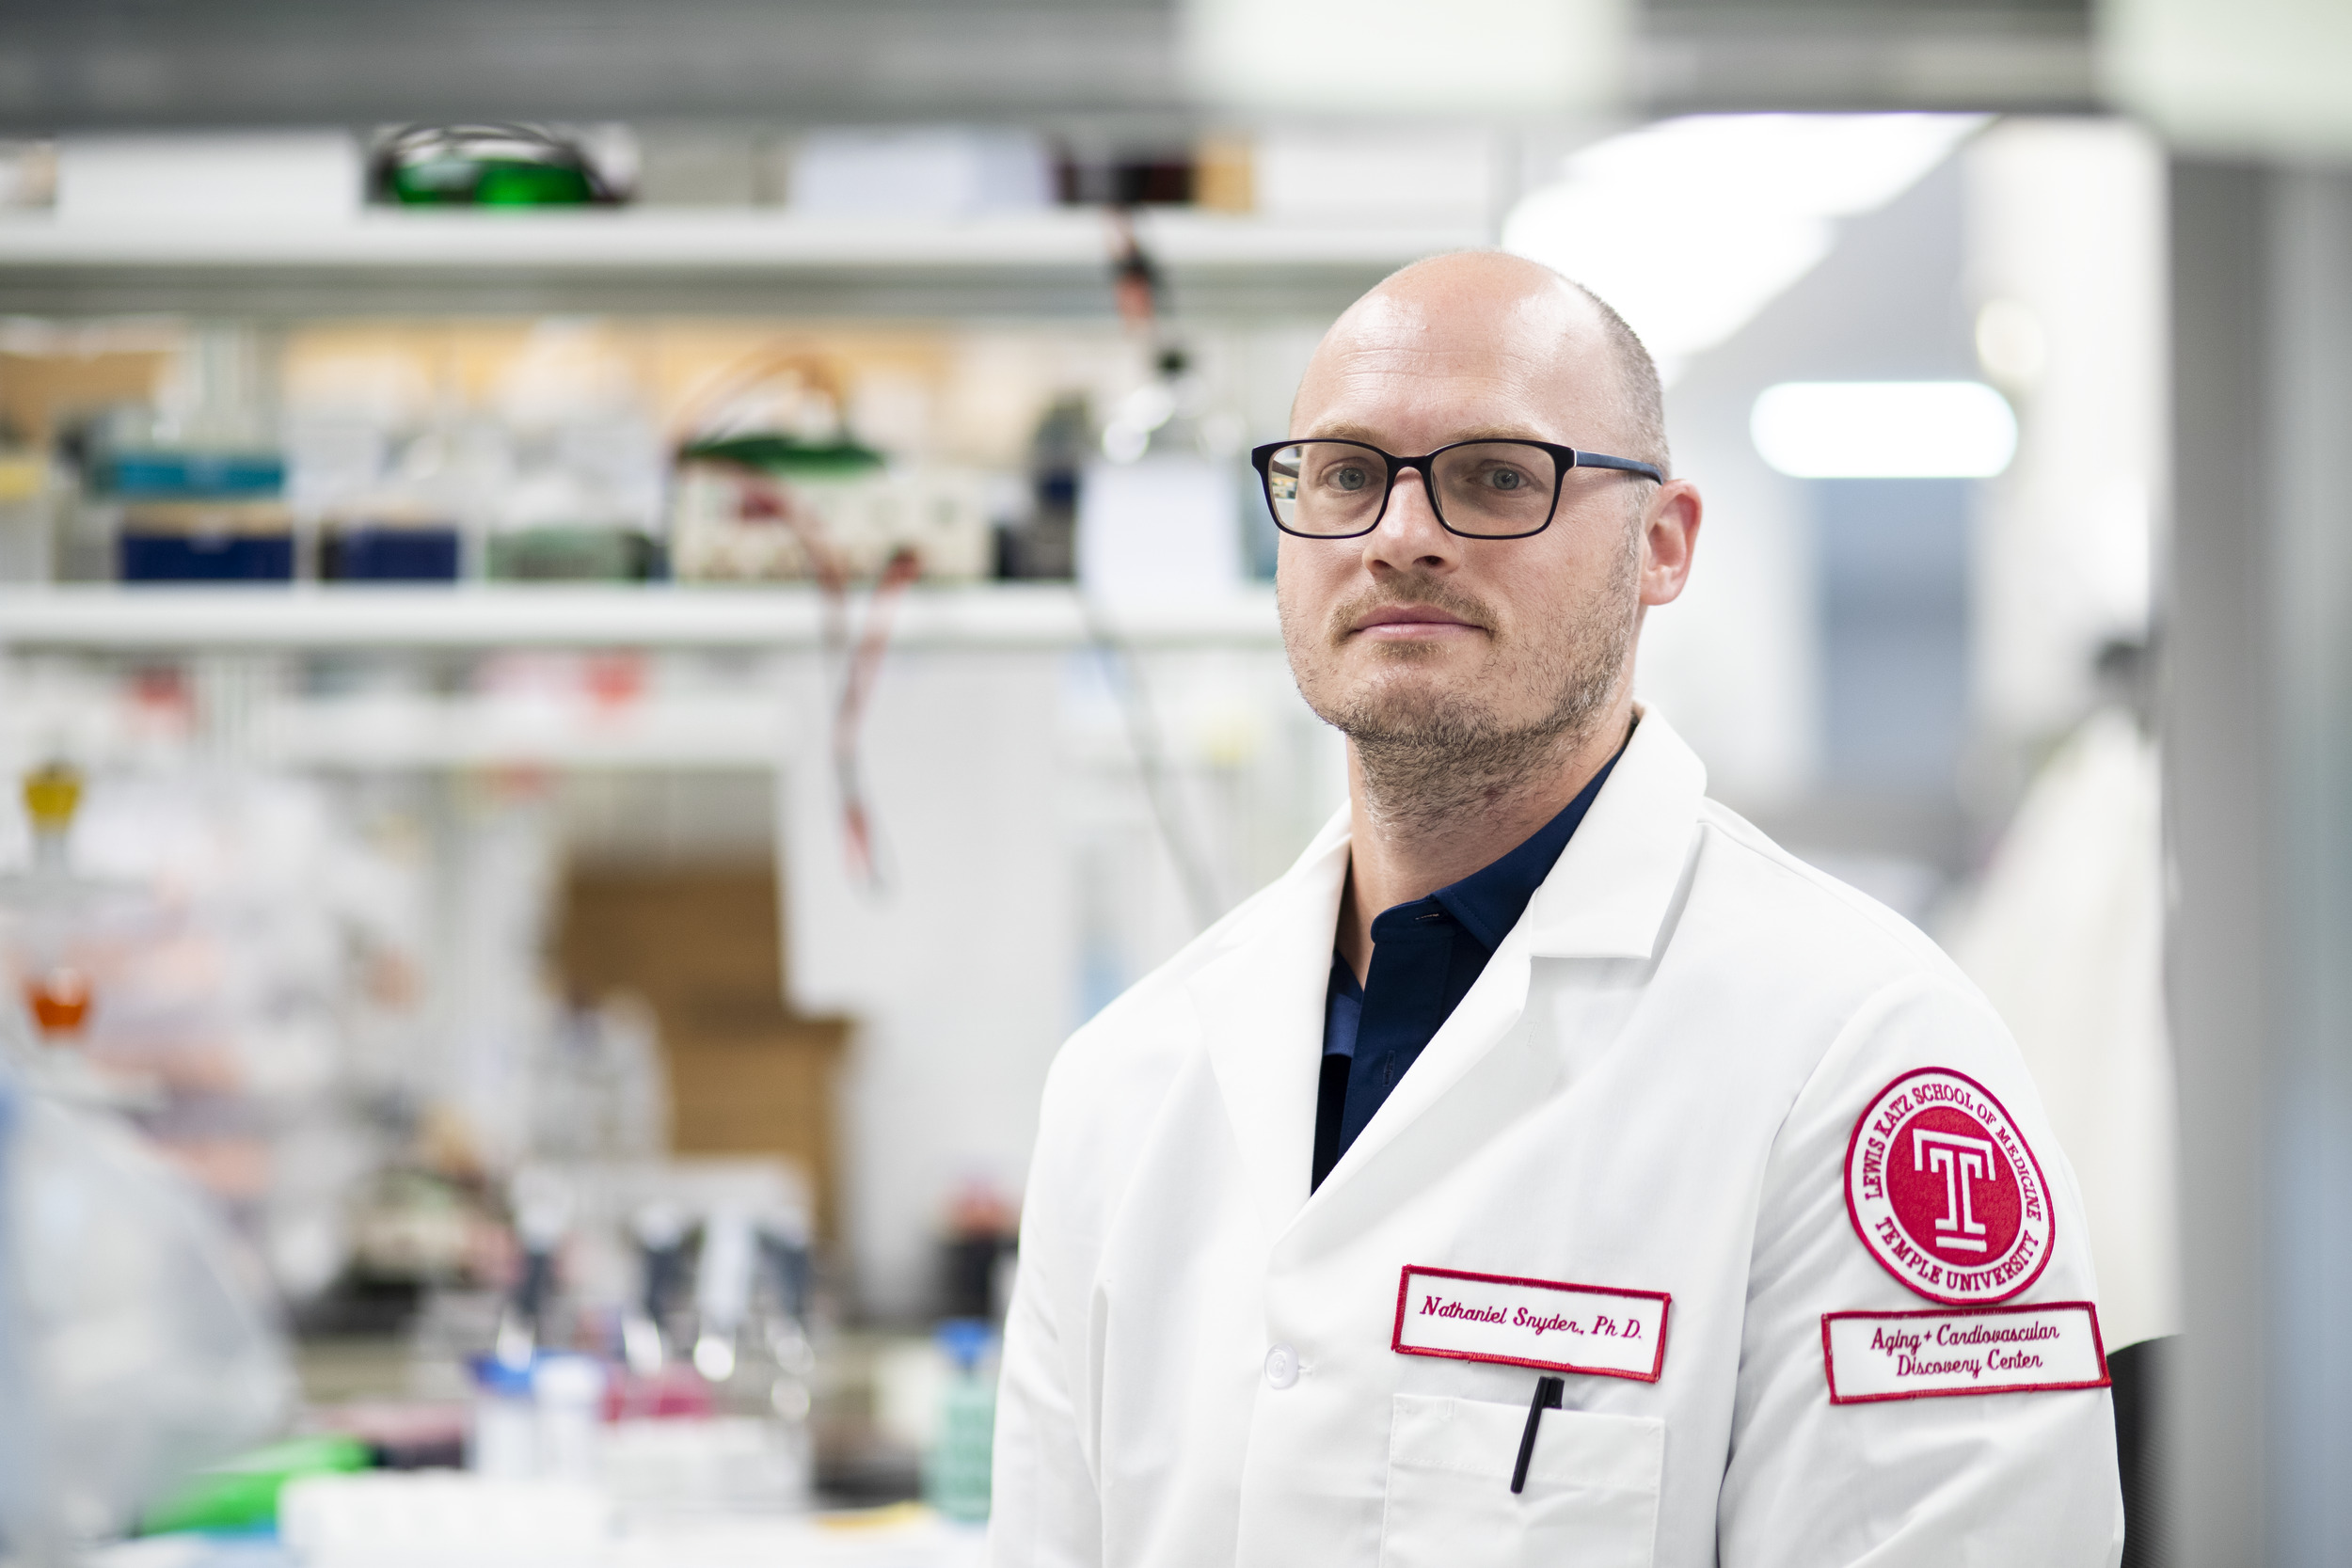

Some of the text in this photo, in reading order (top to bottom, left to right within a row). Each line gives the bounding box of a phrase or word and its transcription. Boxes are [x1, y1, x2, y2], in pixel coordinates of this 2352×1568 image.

[1863, 1084, 2042, 1222] LEWIS KATZ SCHOOL OF MEDICINE
[1876, 1216, 2039, 1291] TEMPLE UNIVERSITY
[1420, 1295, 1506, 1323] Nathaniel
[1513, 1307, 1584, 1336] Snyder,
[1870, 1327, 1921, 1356] Aging
[1936, 1321, 2060, 1346] Cardiovascular
[1896, 1349, 2043, 1379] Discovery Center
